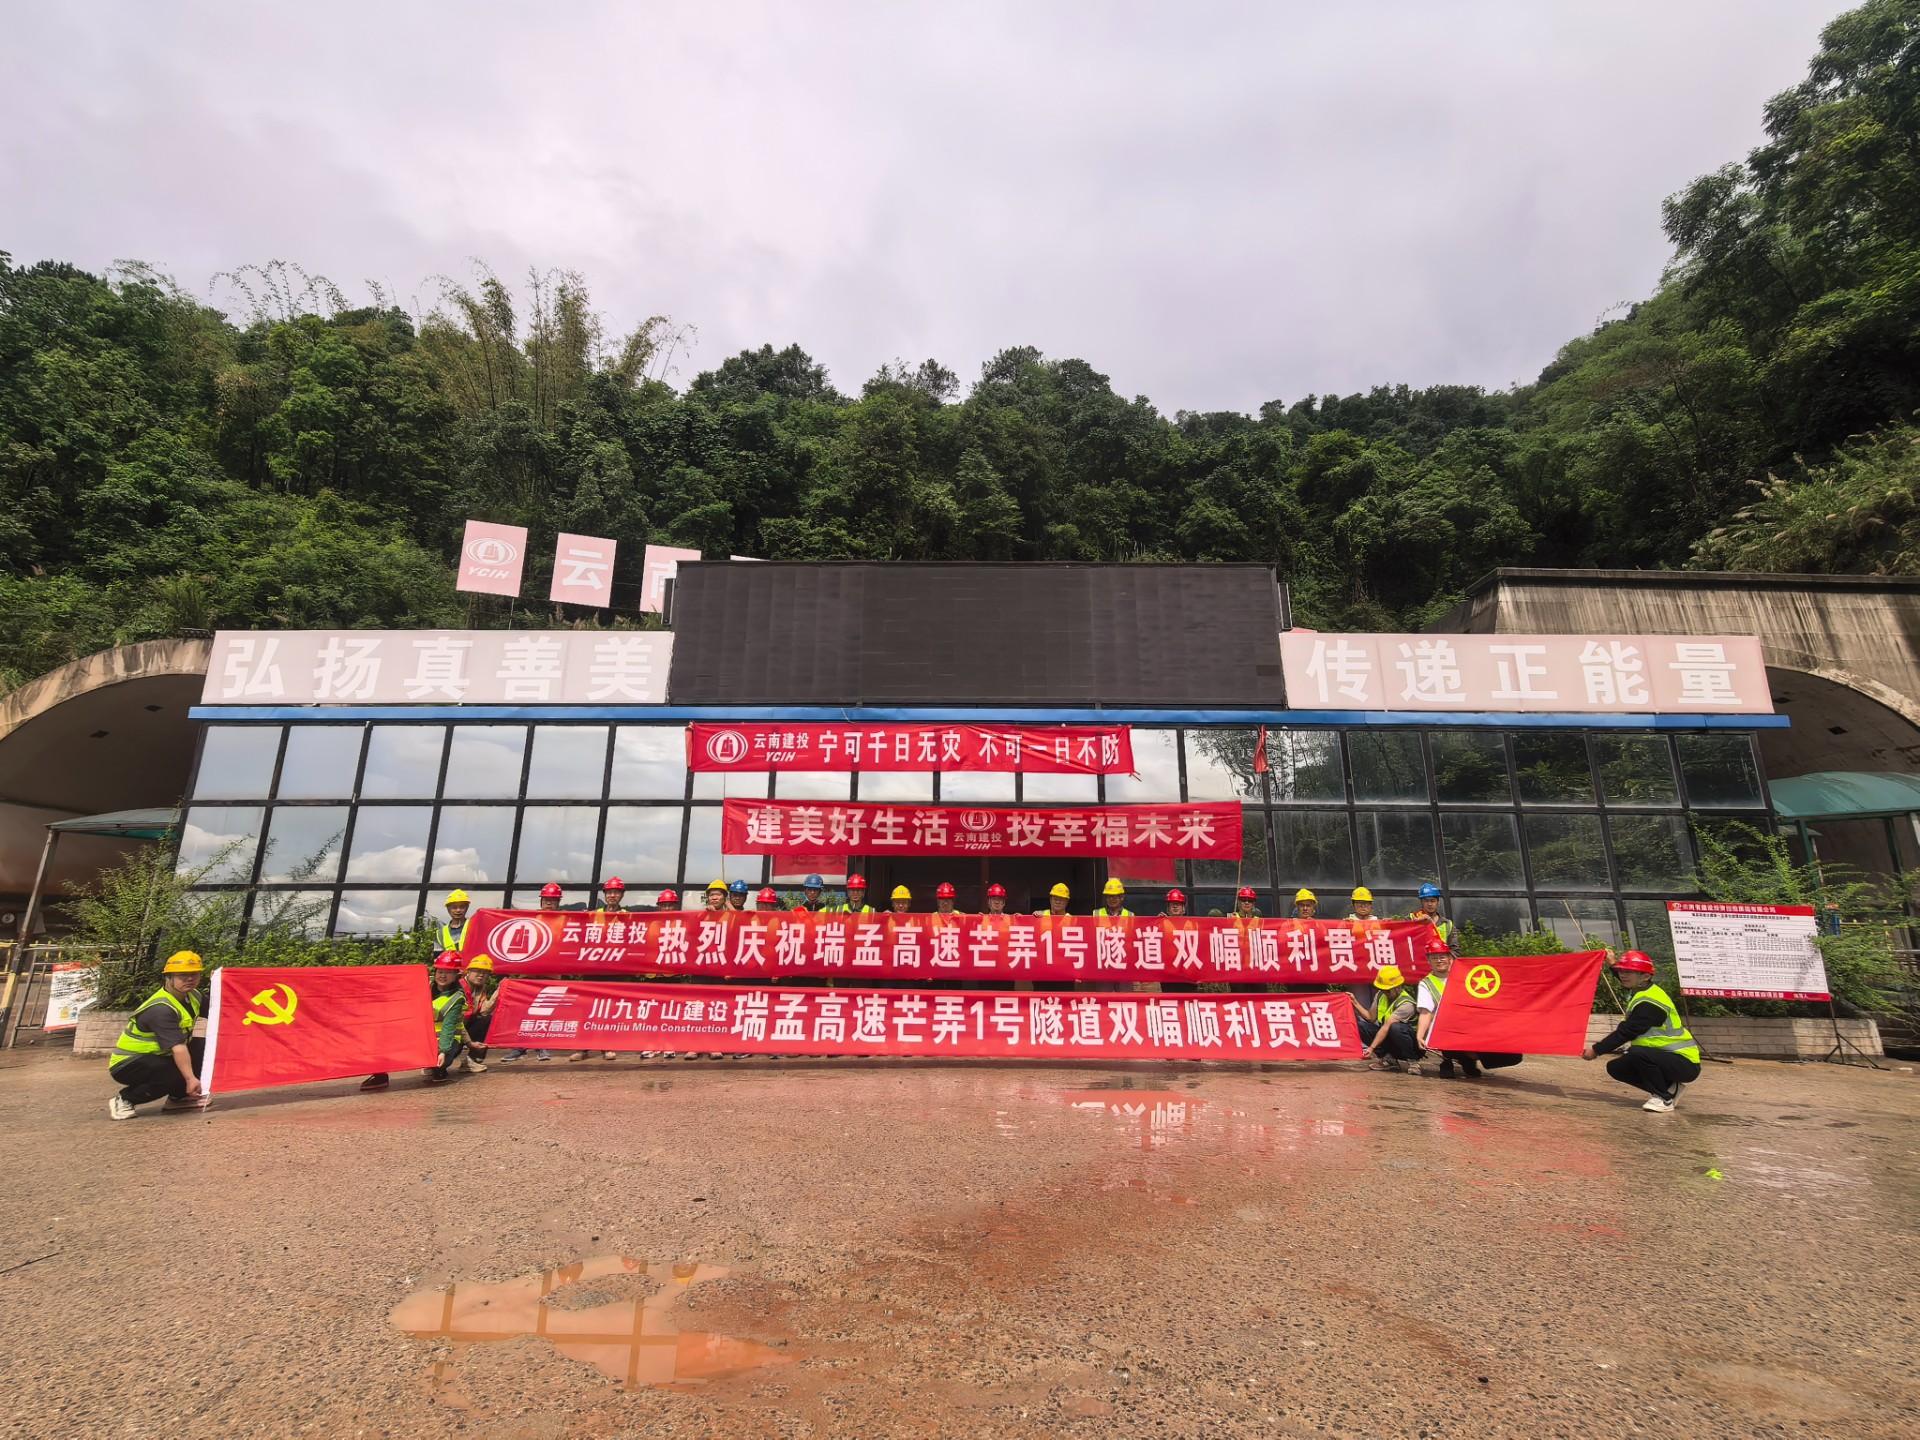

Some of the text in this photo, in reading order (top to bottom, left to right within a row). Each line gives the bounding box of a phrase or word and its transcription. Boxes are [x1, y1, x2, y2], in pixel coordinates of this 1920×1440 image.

[467, 566, 510, 580] YCIH
[561, 548, 608, 590] 云
[222, 636, 653, 700] 弘扬真善美
[1305, 639, 1743, 705] 传递正能量
[753, 732, 809, 750] 云南建投
[818, 729, 1119, 766] 宁可千日无灾 不可一日不防
[765, 751, 797, 762] YCIH
[745, 805, 1217, 849] 建美好生活 投幸福未来
[953, 832, 1002, 843] 云南建投
[562, 921, 648, 944] 云南建投
[577, 947, 627, 962] YCIH
[588, 998, 729, 1022] 川九矿山建设
[731, 990, 1342, 1049] 瑞孟高速芒弄1号隧道双幅顺利贯通
[519, 1019, 579, 1033] 重庆高速
[583, 1021, 728, 1033] Chuanjiu Mine Construction
